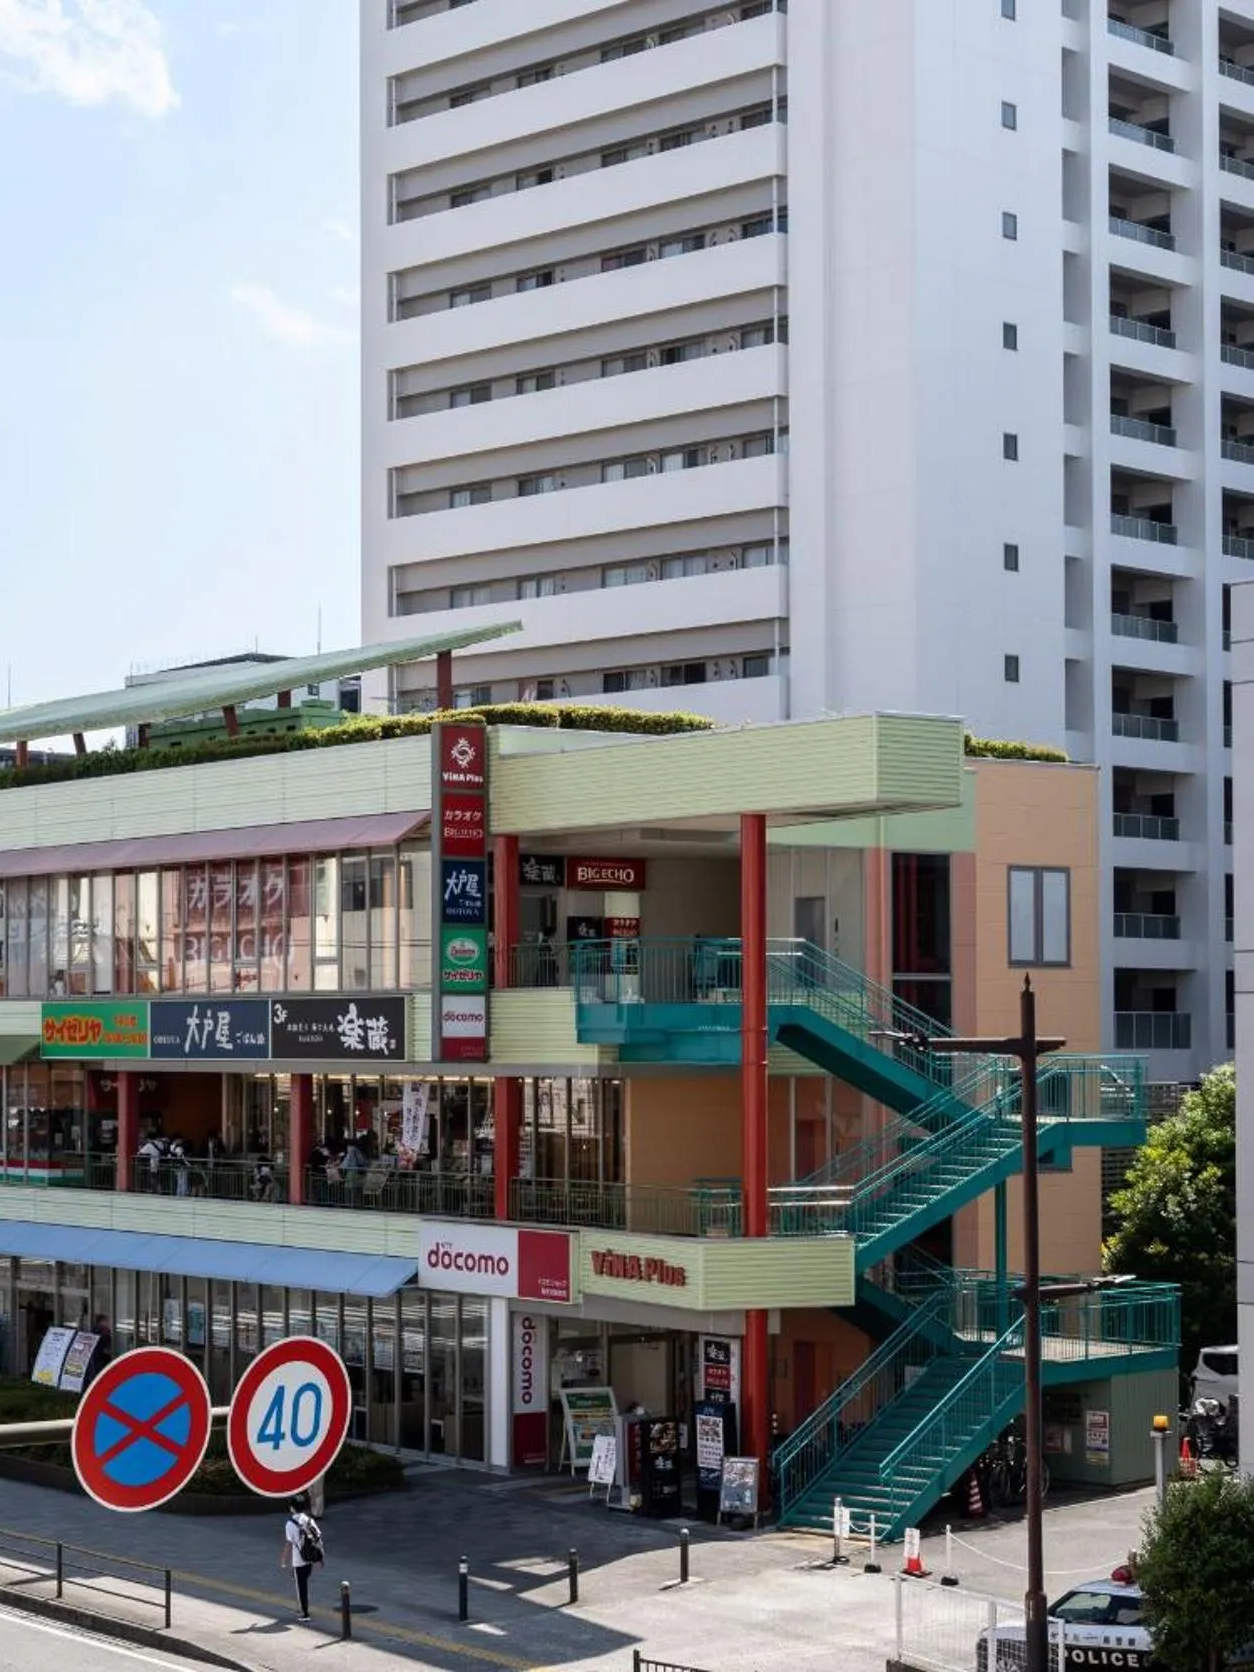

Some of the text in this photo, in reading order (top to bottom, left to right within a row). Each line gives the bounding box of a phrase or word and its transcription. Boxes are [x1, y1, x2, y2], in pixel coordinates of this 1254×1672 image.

[445, 810, 483, 821] カラオケ
[444, 869, 481, 900] 大戸屋
[577, 866, 635, 884] BIG ECHO
[187, 875, 283, 909] カラオケ
[43, 1014, 103, 1045] サイゼリヤ
[184, 1004, 234, 1054] 大戸屋
[273, 1003, 288, 1025] 3F
[337, 1002, 389, 1056] 楽蔵
[443, 1010, 484, 1023] docomo
[427, 1242, 510, 1276] docomo
[521, 1316, 535, 1405] docomo
[257, 1382, 323, 1450] 40
